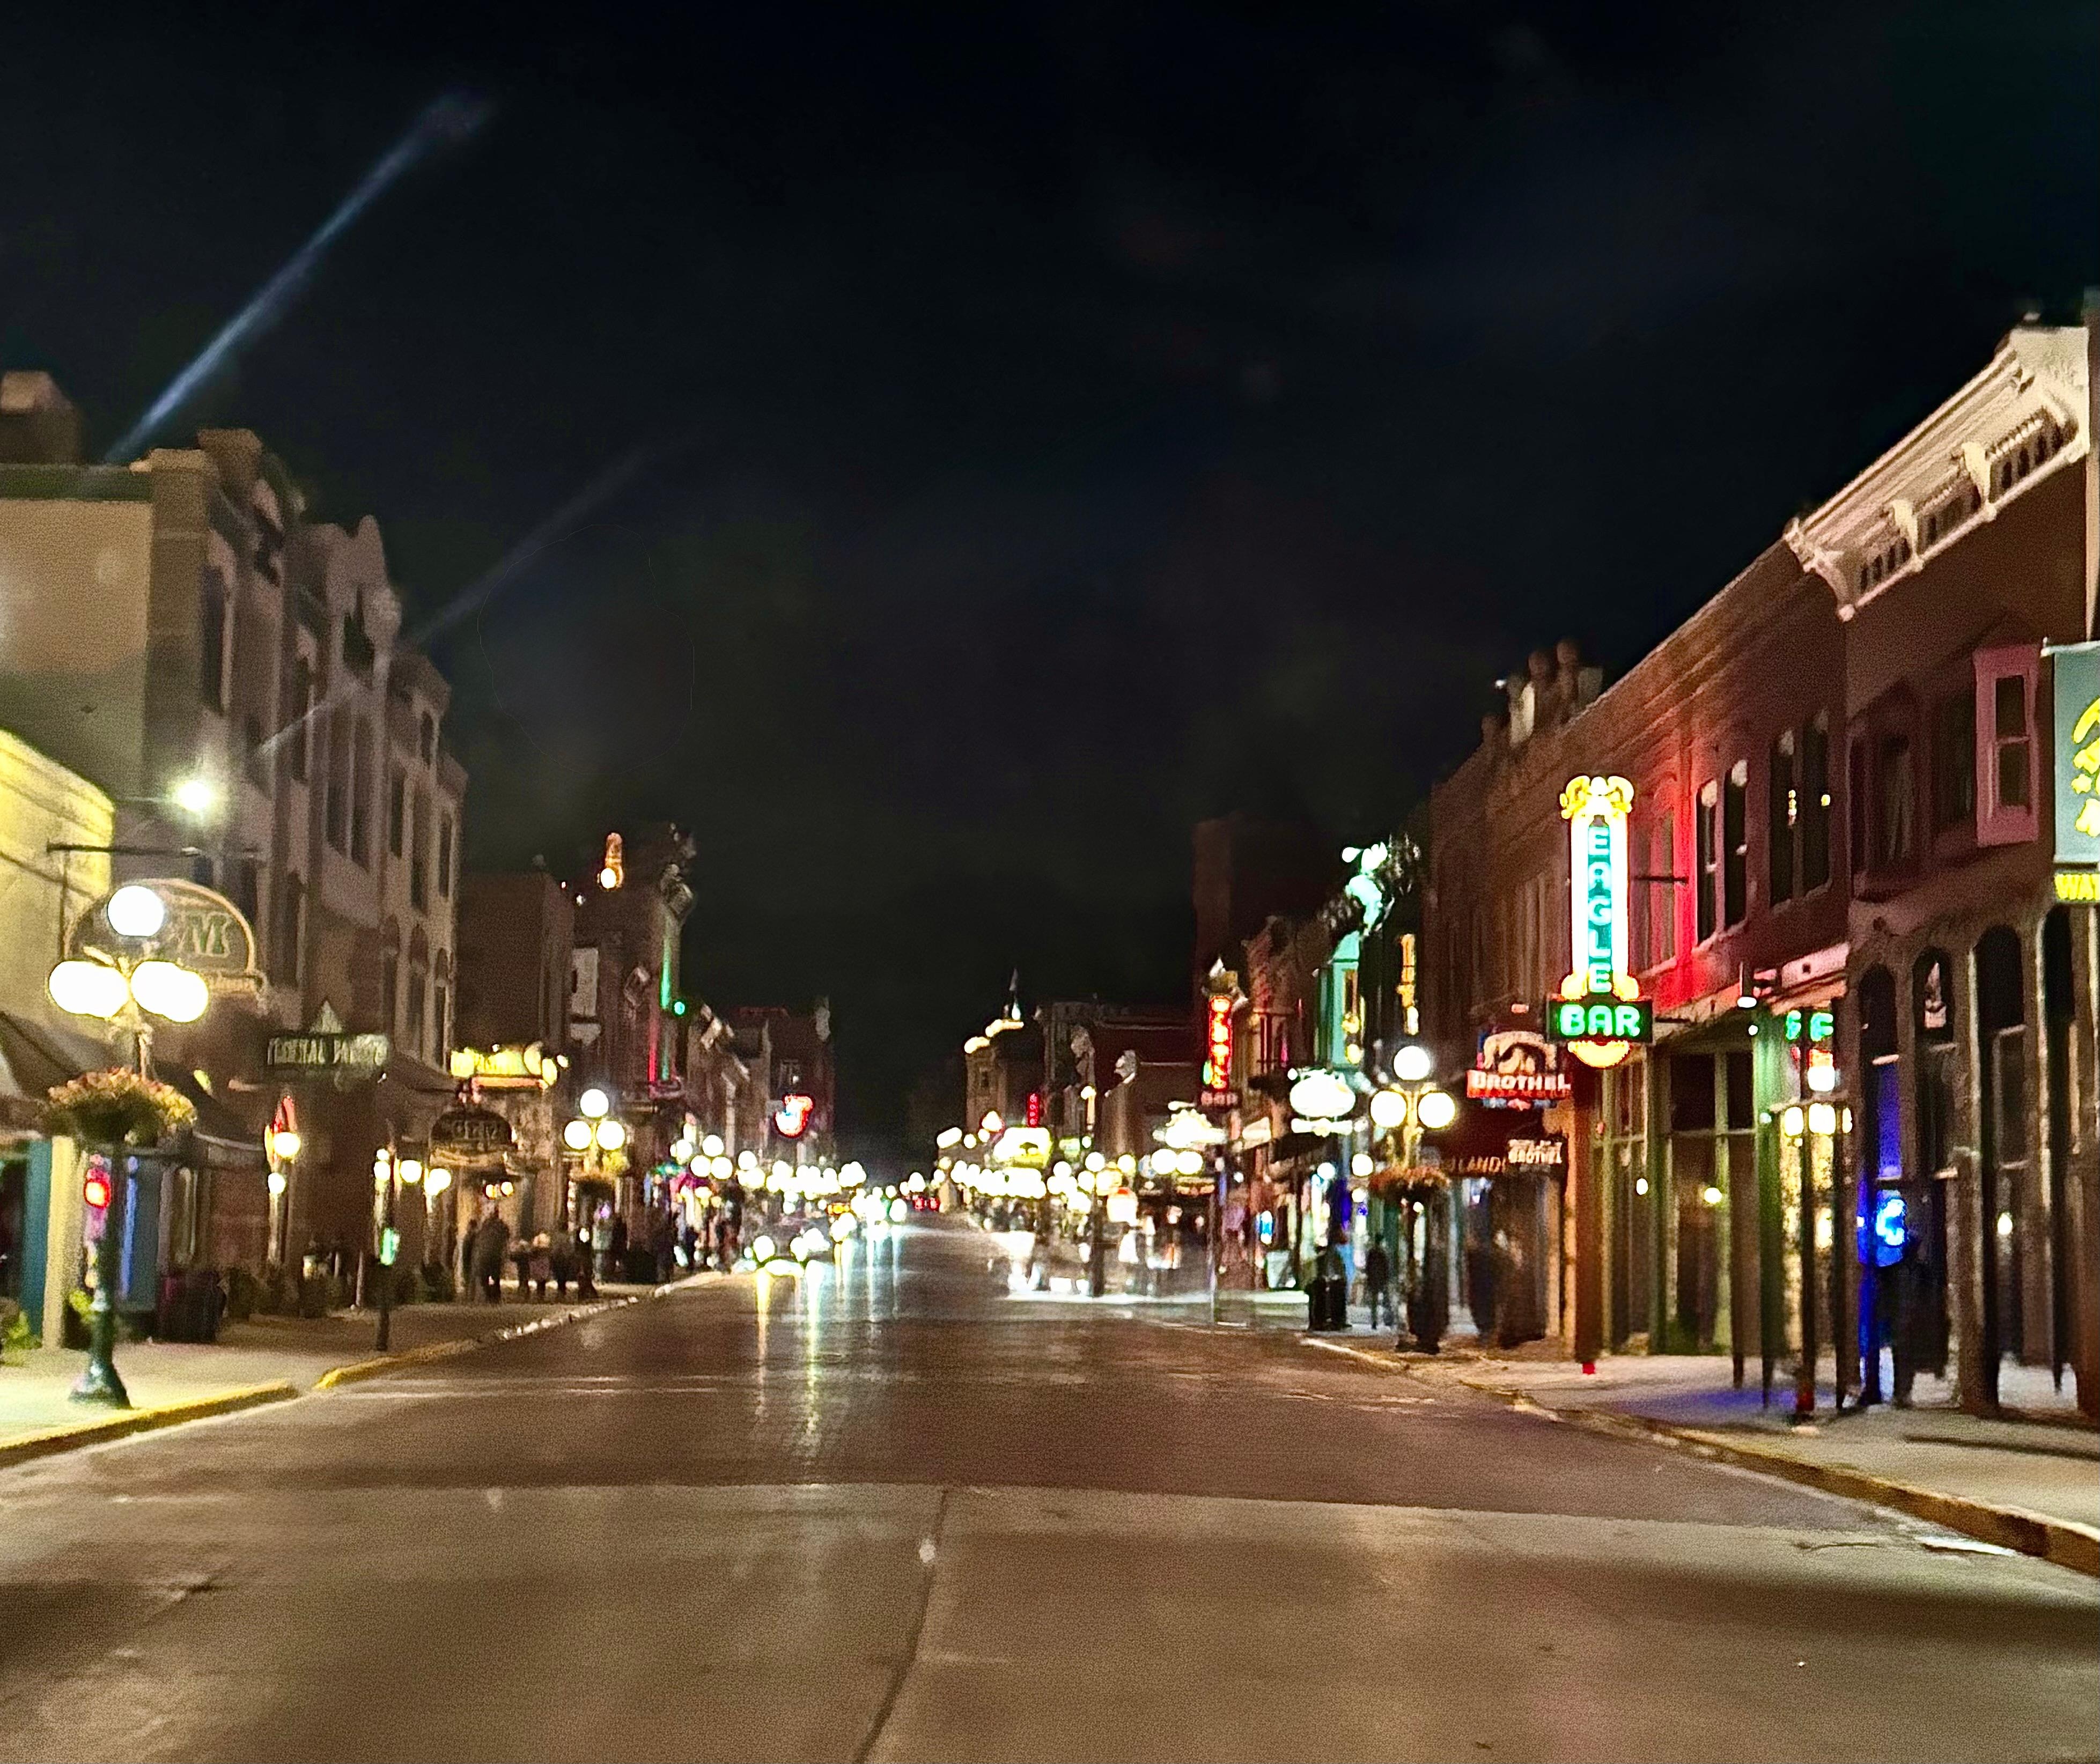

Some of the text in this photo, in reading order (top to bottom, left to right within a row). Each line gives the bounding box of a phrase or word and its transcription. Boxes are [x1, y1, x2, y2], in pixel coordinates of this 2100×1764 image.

[2054, 874, 2100, 901] WA
[1587, 826, 1612, 993] EAGLE
[1559, 1004, 1641, 1037] BAR
